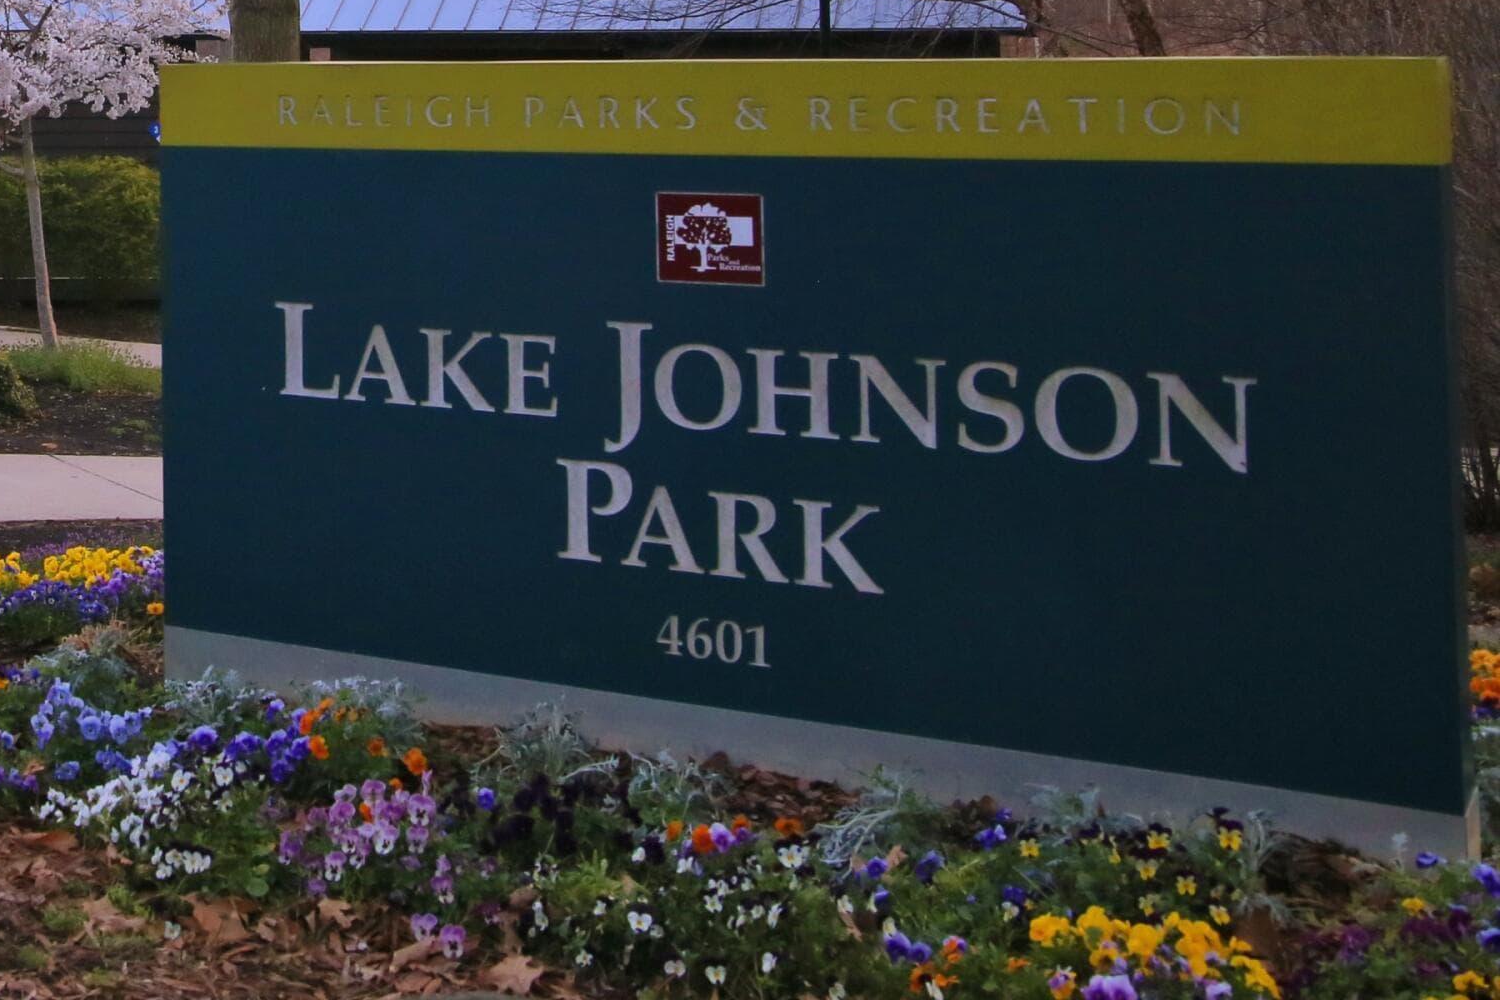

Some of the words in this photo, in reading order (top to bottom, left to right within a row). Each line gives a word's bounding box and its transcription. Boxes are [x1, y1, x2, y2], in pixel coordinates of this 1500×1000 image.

[277, 94, 490, 128] RALEIGH
[523, 95, 698, 130] PARKS
[734, 95, 768, 132] &
[807, 95, 1242, 136] RECREATION
[665, 215, 675, 261] RALEIGH
[275, 301, 558, 418] LAKE
[603, 320, 1258, 474] JOHNSON
[556, 458, 885, 595] PARK
[656, 614, 771, 668] 4601
